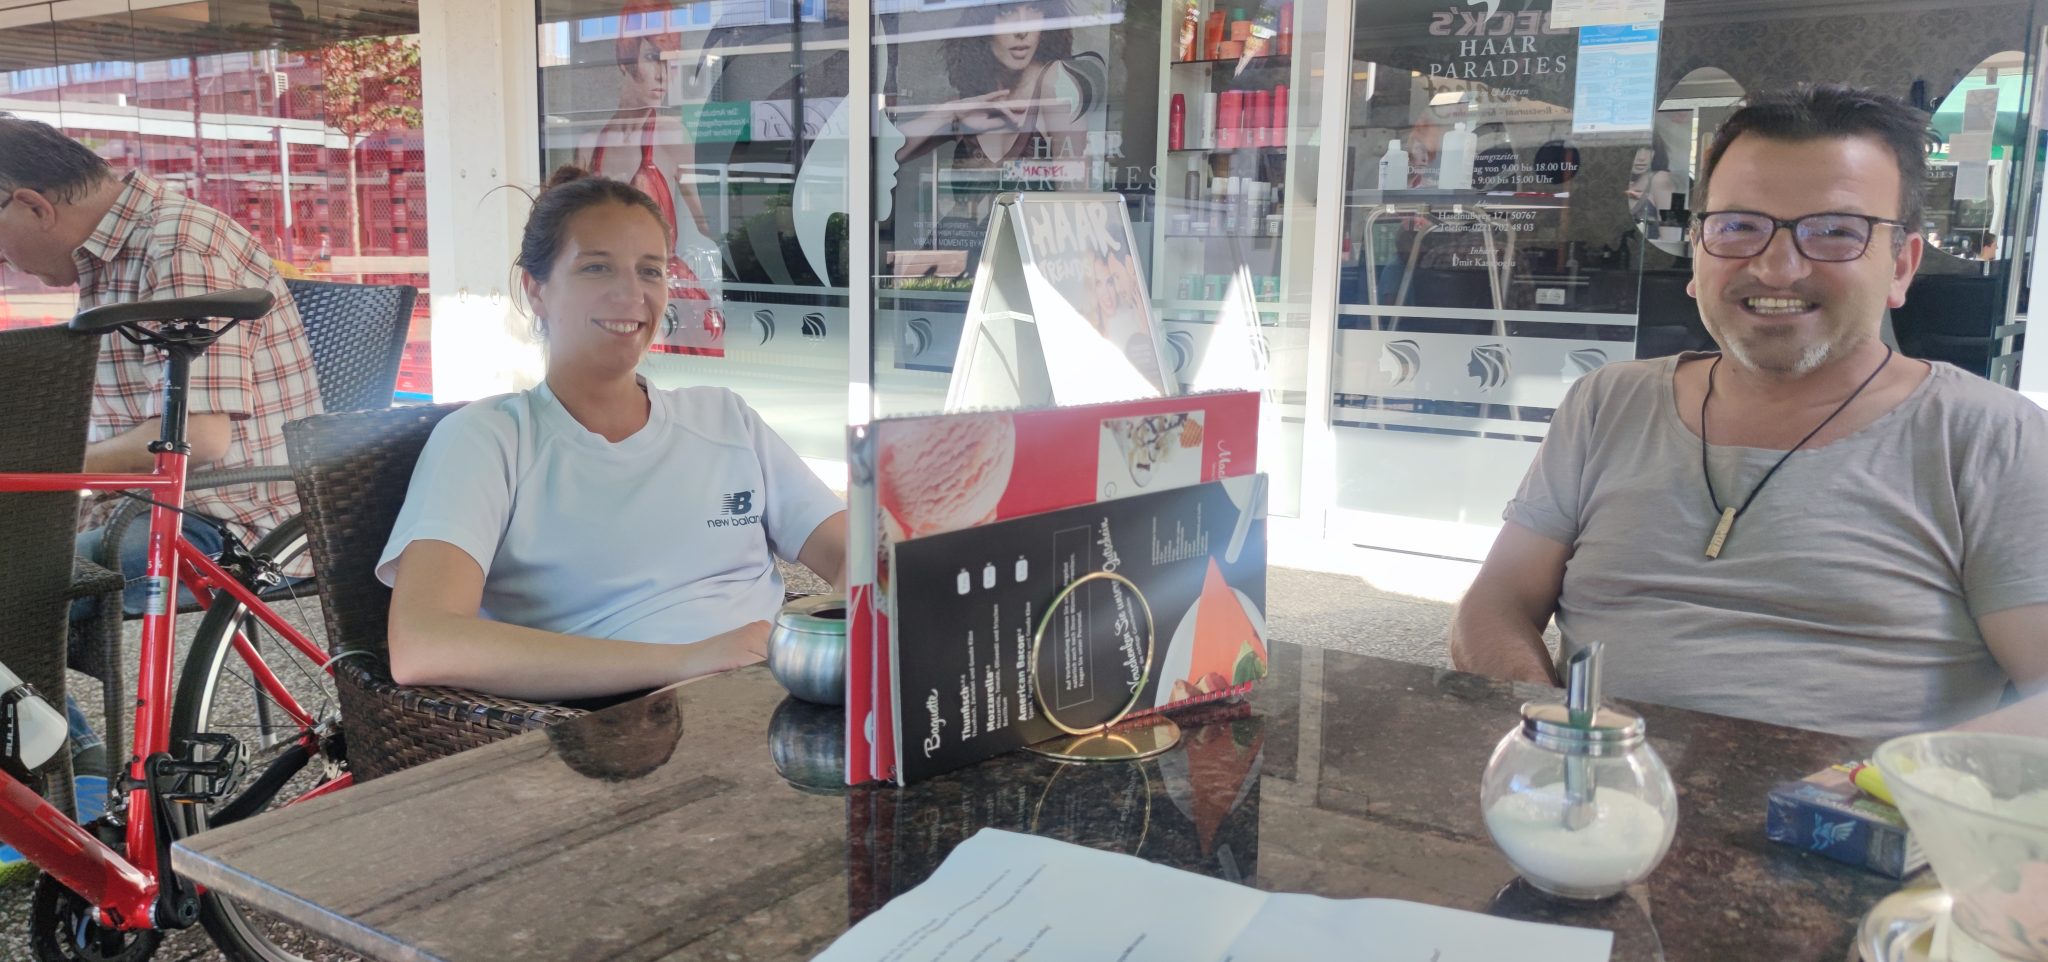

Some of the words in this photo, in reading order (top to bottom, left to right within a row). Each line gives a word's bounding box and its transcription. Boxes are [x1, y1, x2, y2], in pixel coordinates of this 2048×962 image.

[1458, 35, 1538, 57] HAAR
[1429, 55, 1568, 80] PARADIES
[1031, 133, 1126, 160] HAAR
[998, 166, 1162, 191] PARADIES
[1484, 165, 1499, 173] von
[1501, 163, 1520, 172] 9.00
[1521, 163, 1533, 172] bis
[1535, 163, 1559, 172] 18.00
[1560, 162, 1578, 172] Uhr
[1511, 175, 1534, 184] 15.00
[1536, 174, 1553, 184] Uhr
[1511, 211, 1537, 220] 50767
[1512, 223, 1522, 232] 48
[1523, 223, 1535, 232] 03
[1031, 201, 1121, 257] HAAR
[707, 518, 730, 528] new
[731, 514, 761, 527] balan
[1114, 611, 1128, 636] Sie
[1016, 635, 1025, 669] Bacon
[1119, 632, 1140, 693] Verschenken
[985, 671, 995, 732] Mozzarella
[1017, 670, 1027, 721] American
[924, 688, 946, 758] Baguette
[961, 686, 971, 741] Thunfisch
[5, 703, 14, 757] BULLS
